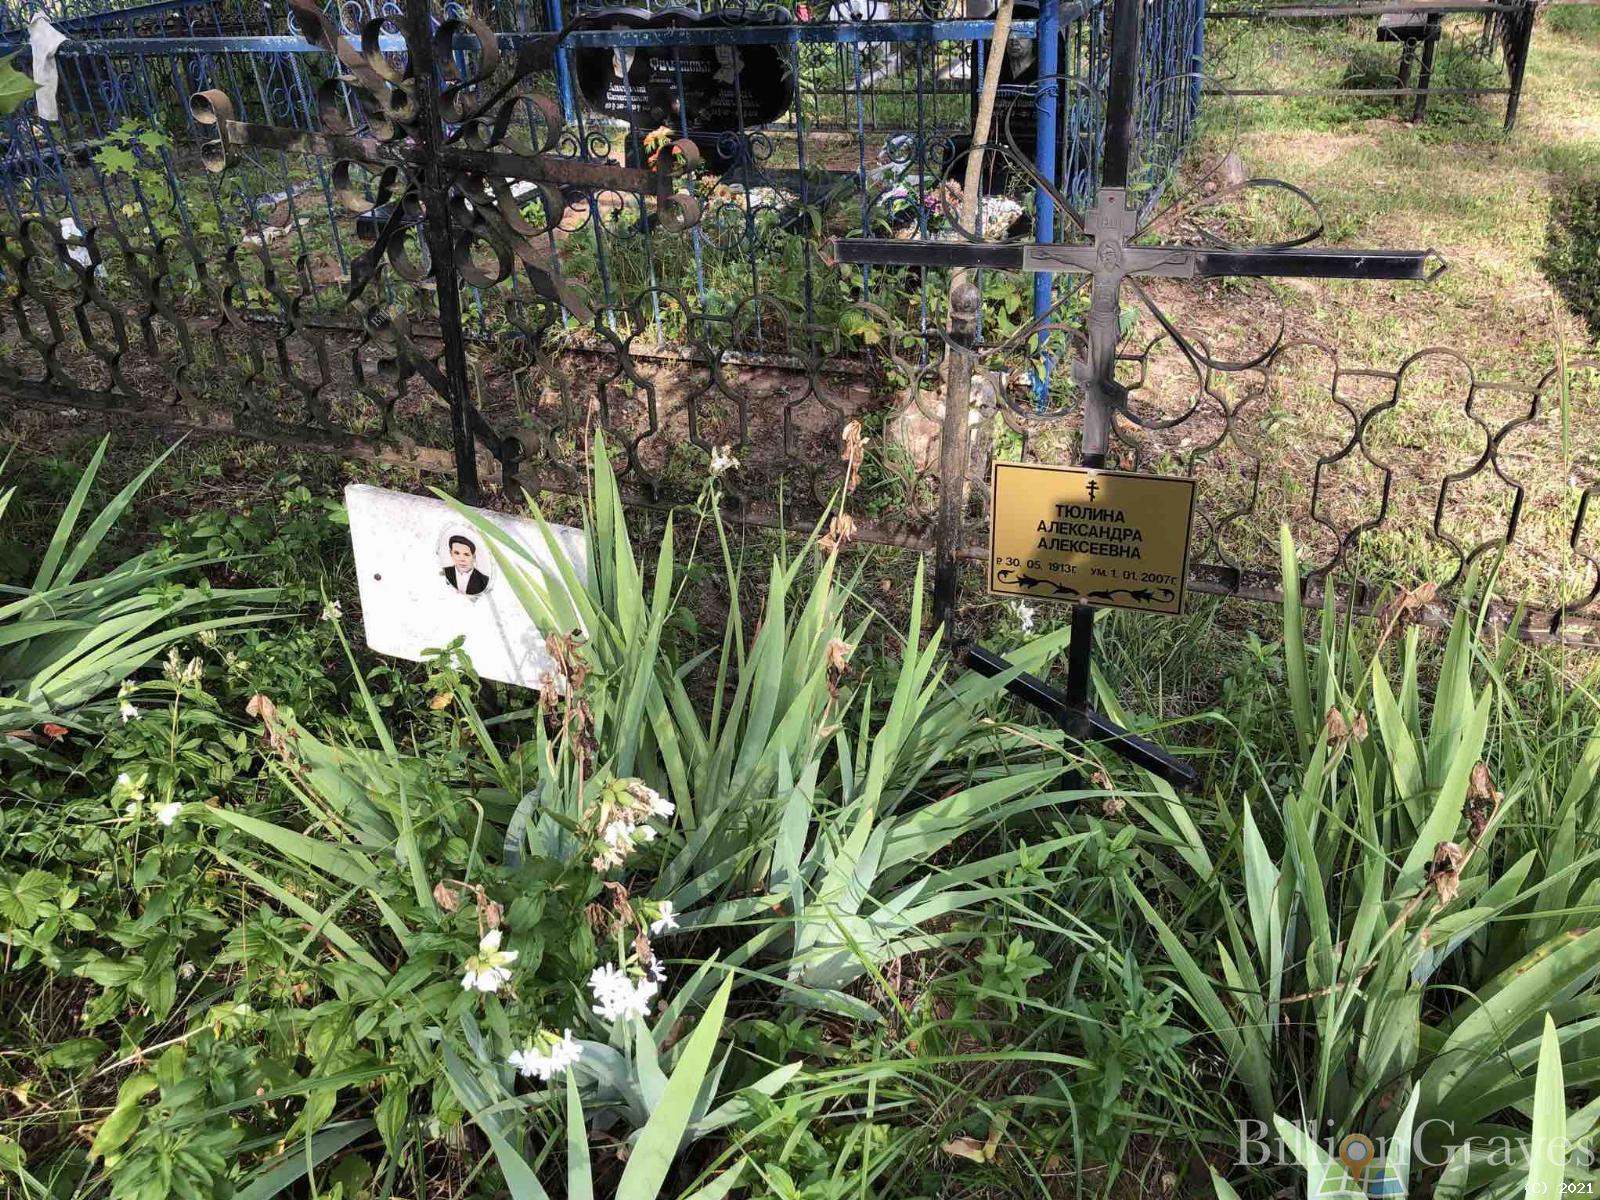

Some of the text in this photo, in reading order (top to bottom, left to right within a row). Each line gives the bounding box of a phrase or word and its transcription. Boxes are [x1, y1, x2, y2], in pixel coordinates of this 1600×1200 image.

[1055, 504, 1126, 523] ТЮЛИНА
[1037, 520, 1143, 542] АЛЕКСАНДРА
[1037, 538, 1142, 559] АЛЕКСЕЕВНА
